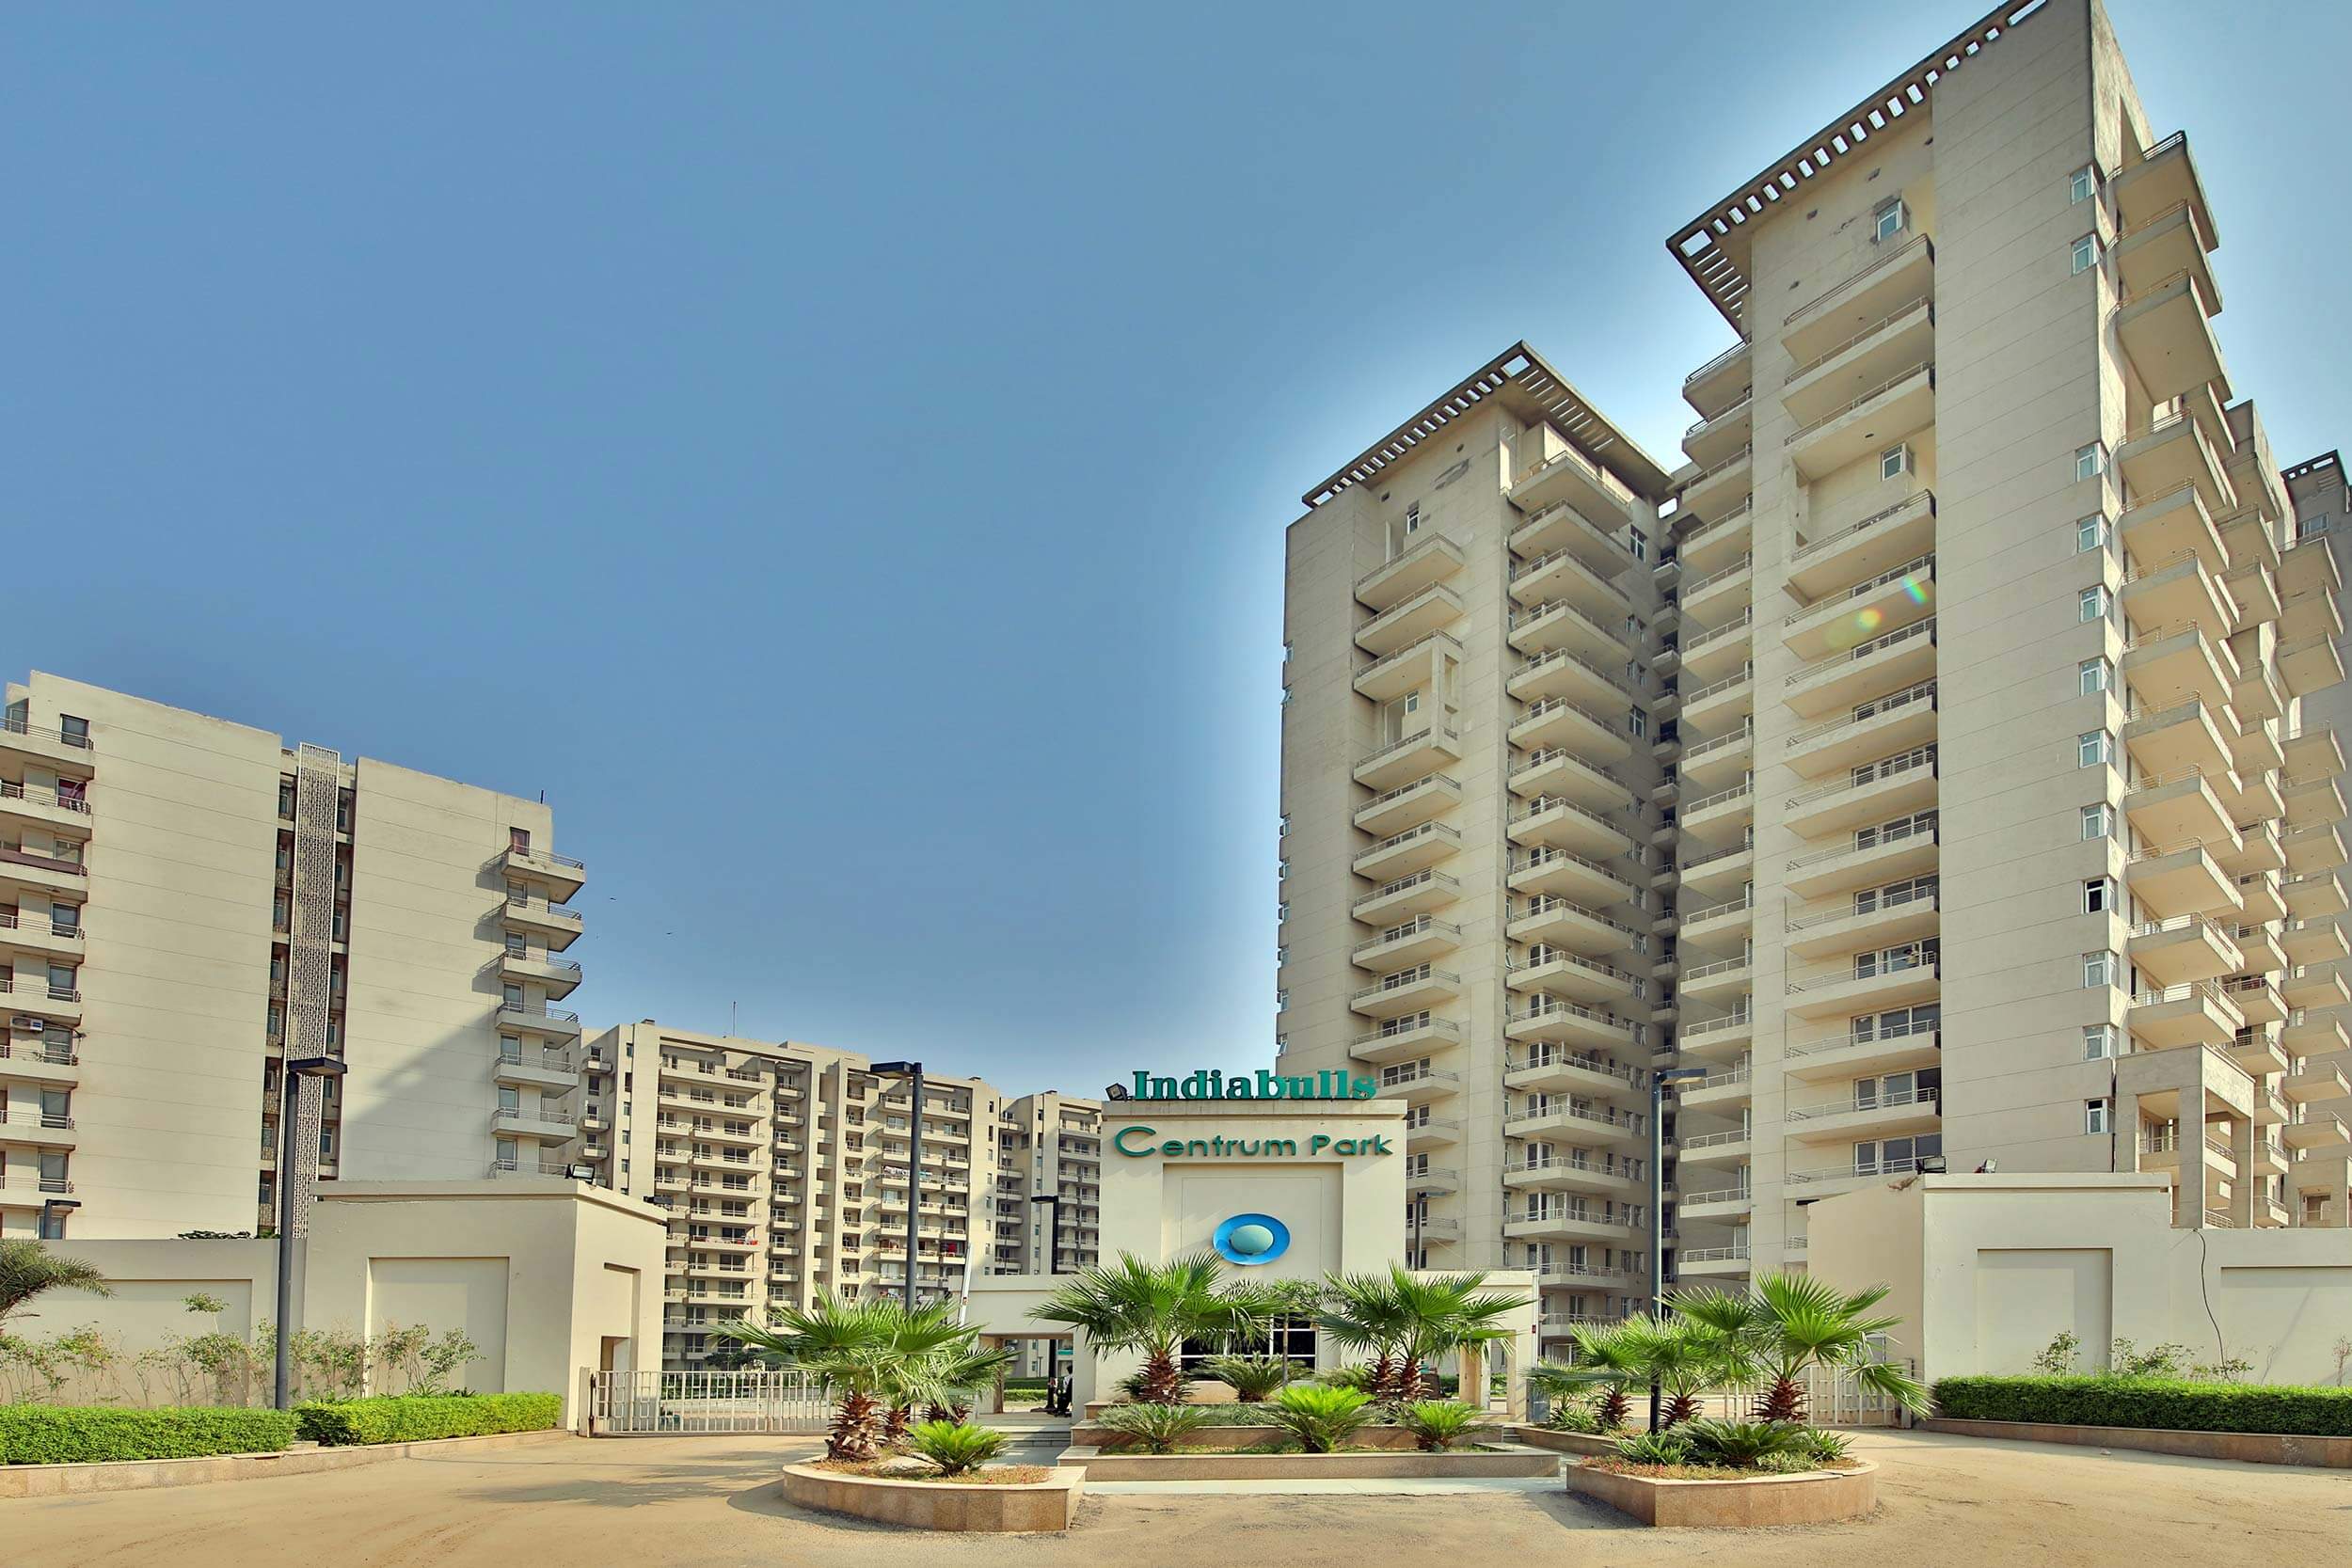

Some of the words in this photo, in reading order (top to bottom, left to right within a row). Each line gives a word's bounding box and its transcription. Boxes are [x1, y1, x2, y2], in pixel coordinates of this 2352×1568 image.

[1133, 1069, 1377, 1100] Indiabulls
[1114, 1126, 1296, 1157] Centrum
[1311, 1133, 1393, 1156] Park
